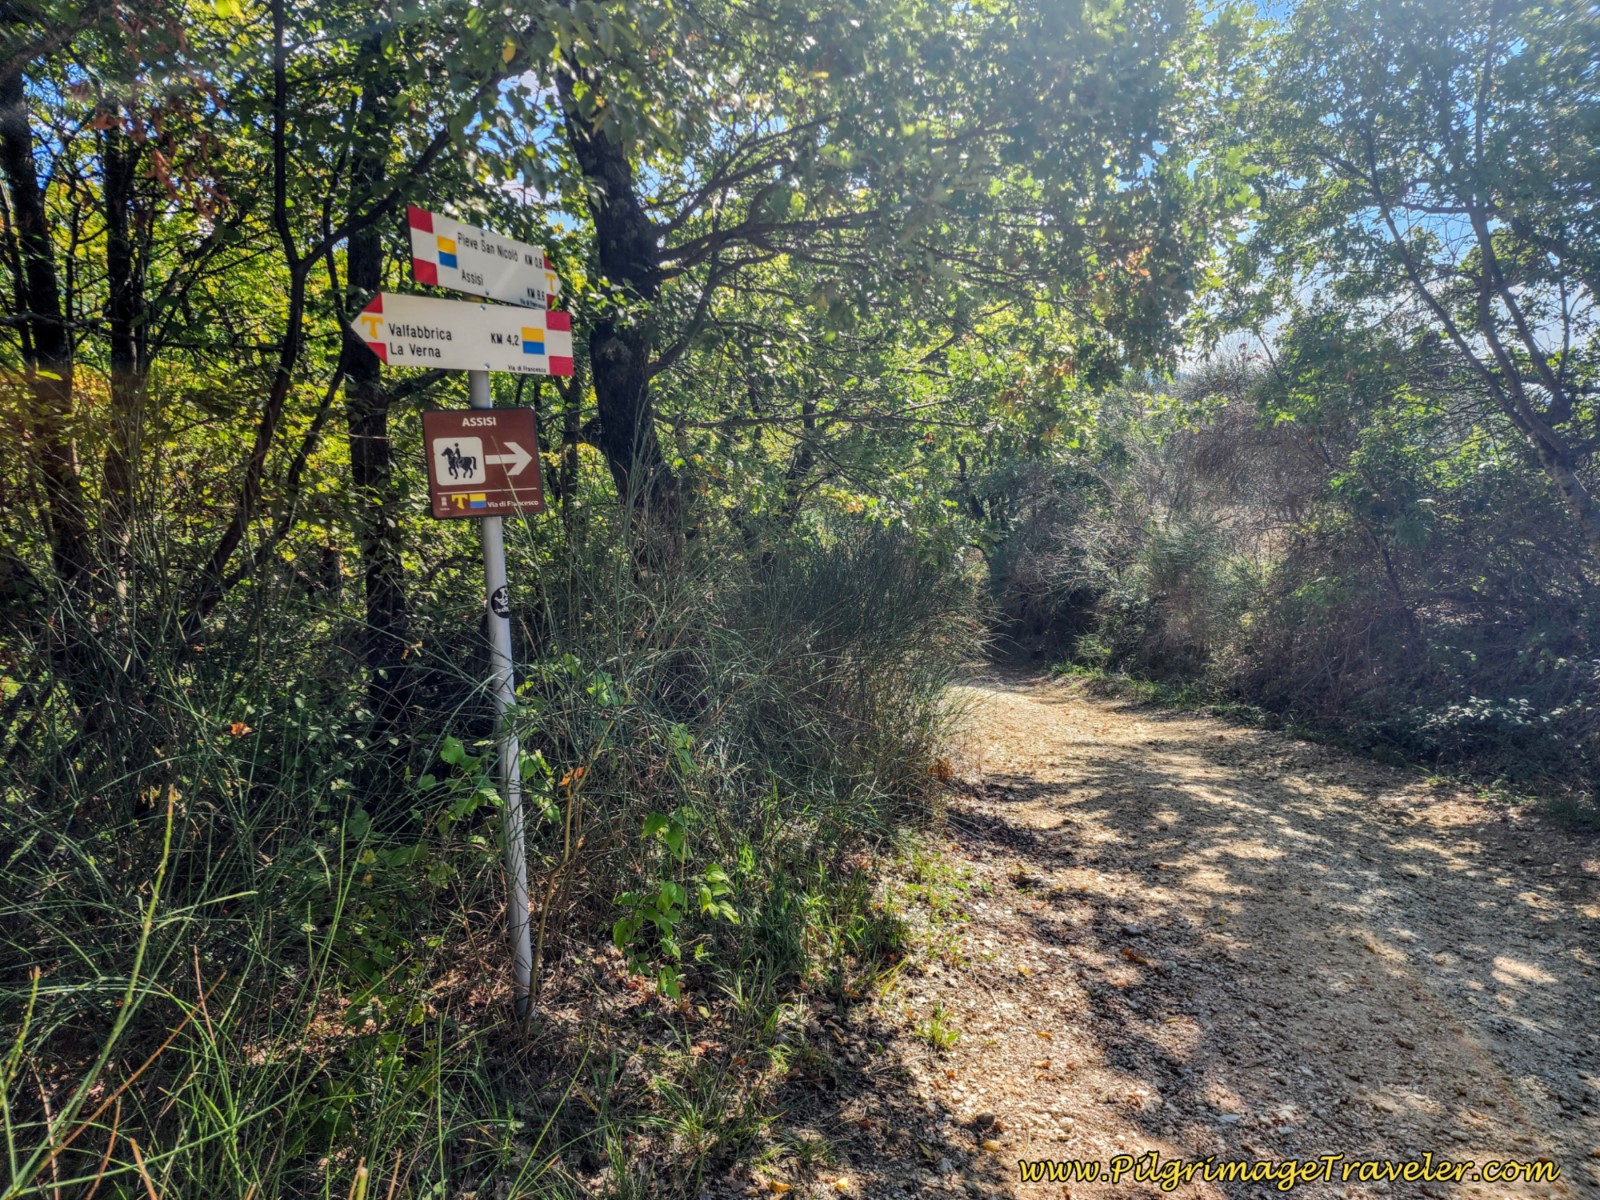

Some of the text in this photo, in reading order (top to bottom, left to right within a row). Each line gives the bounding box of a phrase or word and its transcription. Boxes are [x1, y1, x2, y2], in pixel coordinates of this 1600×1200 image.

[457, 232, 479, 250] Pieve
[481, 239, 496, 255] San
[524, 254, 533, 266] KM
[461, 269, 484, 286] Assisi
[526, 287, 535, 298] KM
[388, 323, 519, 347] Valfabbrica KM 4,2
[389, 343, 441, 358] La Verna
[462, 417, 497, 427] ASSISI
[499, 500, 506, 508] di
